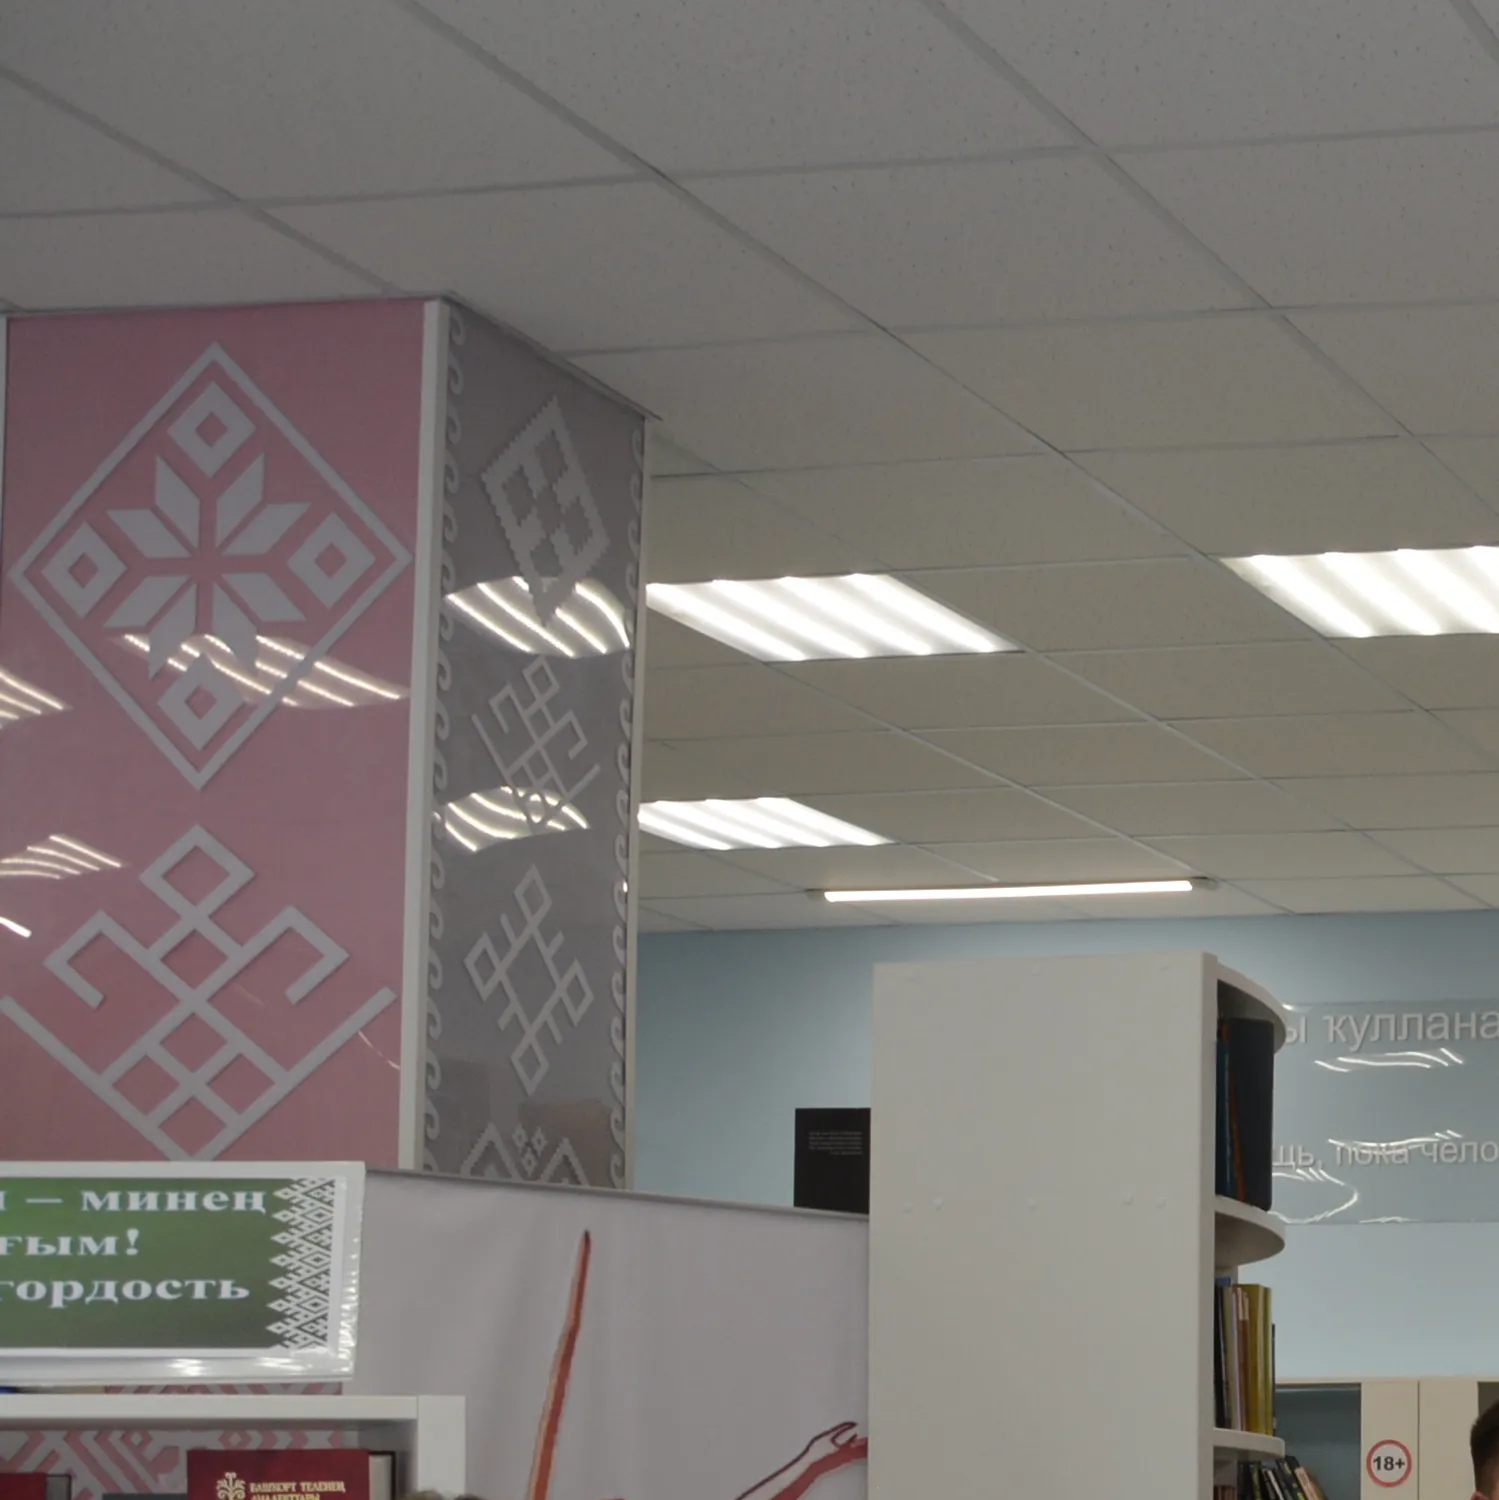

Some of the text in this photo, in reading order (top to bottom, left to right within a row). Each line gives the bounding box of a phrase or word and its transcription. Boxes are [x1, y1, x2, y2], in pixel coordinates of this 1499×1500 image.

[1336, 1143, 1409, 1165] пока
[81, 1190, 267, 1214] минең
[1373, 1456, 1406, 1471] 18+
